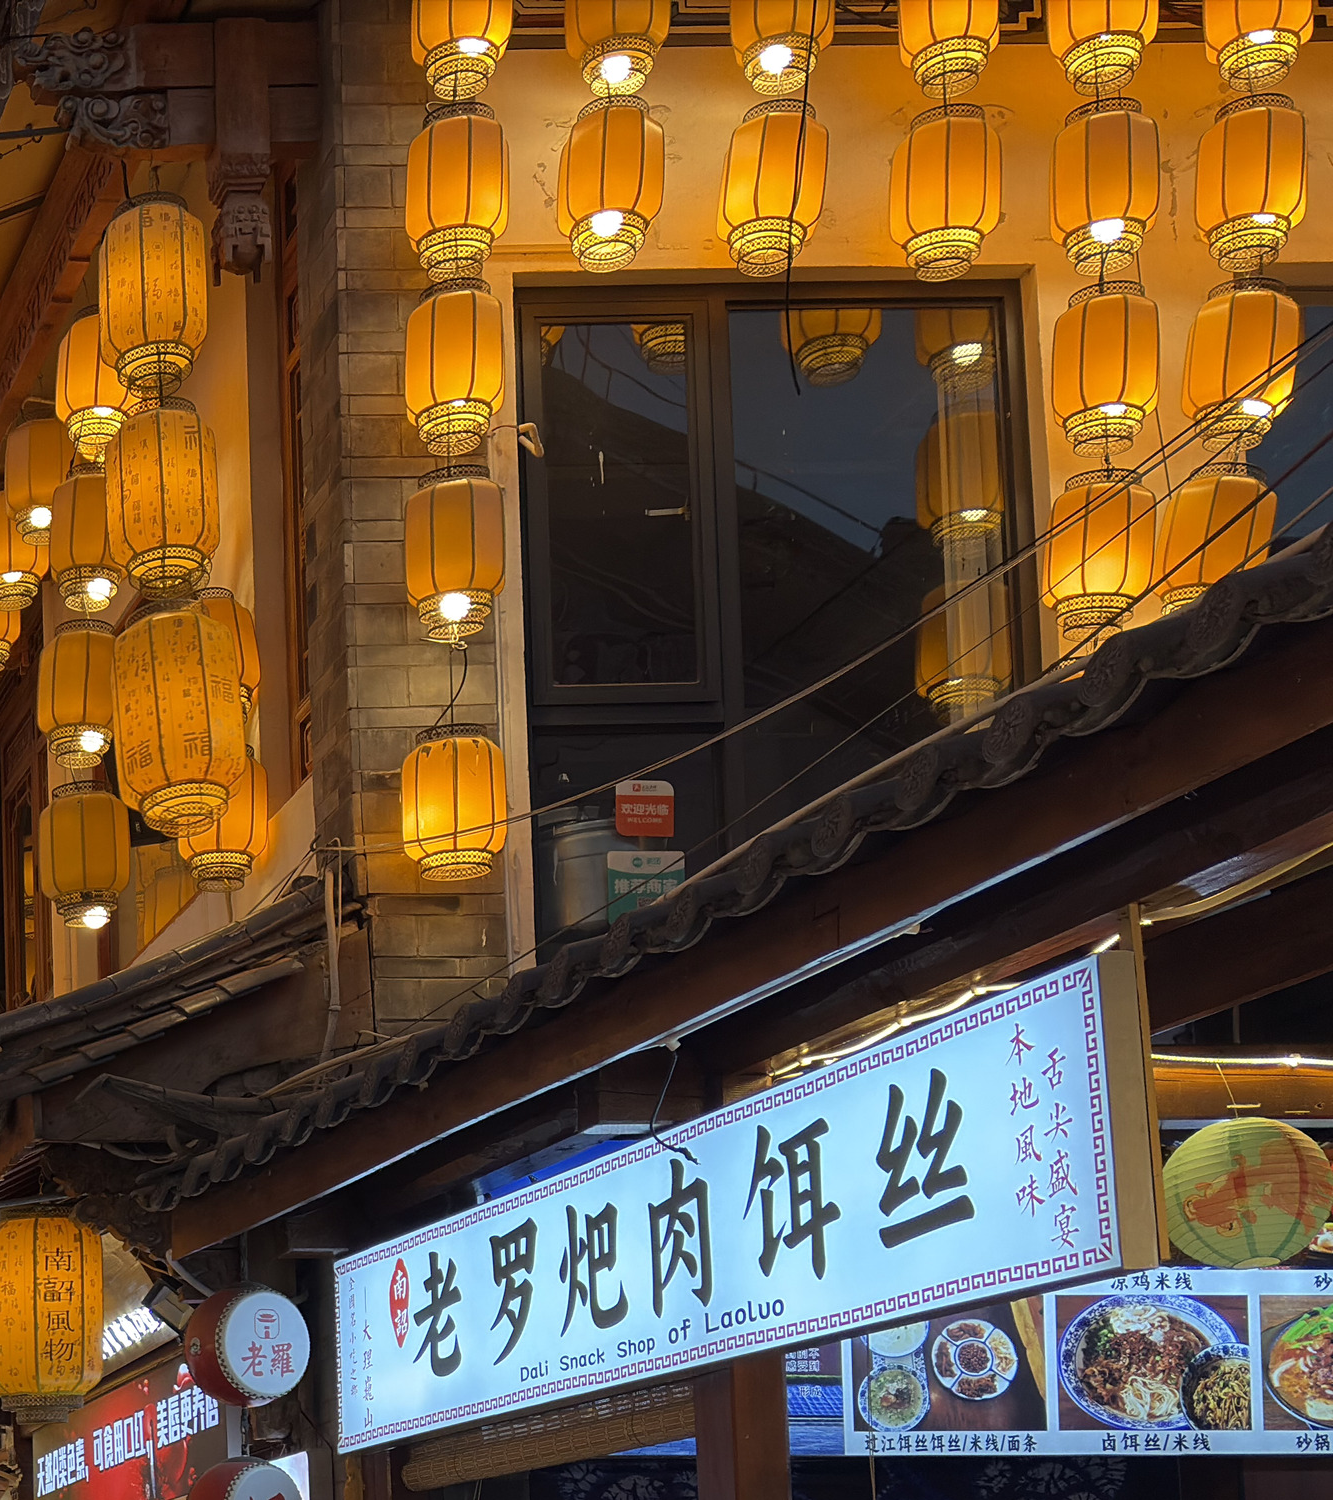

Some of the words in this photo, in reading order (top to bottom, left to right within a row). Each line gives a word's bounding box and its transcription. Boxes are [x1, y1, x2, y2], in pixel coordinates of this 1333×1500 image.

[620, 803, 669, 816] 欢迎光临
[1042, 1044, 1079, 1250] 舌尖盛宴
[520, 1360, 549, 1382] Dali
[559, 1349, 605, 1371] Snack
[617, 1334, 655, 1361] Shop
[668, 1319, 692, 1345] of
[705, 1299, 785, 1334] Laoluo
[241, 1341, 296, 1378] 老羅
[1101, 1431, 1211, 1453] 卤饵丝/米线
[1296, 1432, 1331, 1453] 砂锅
